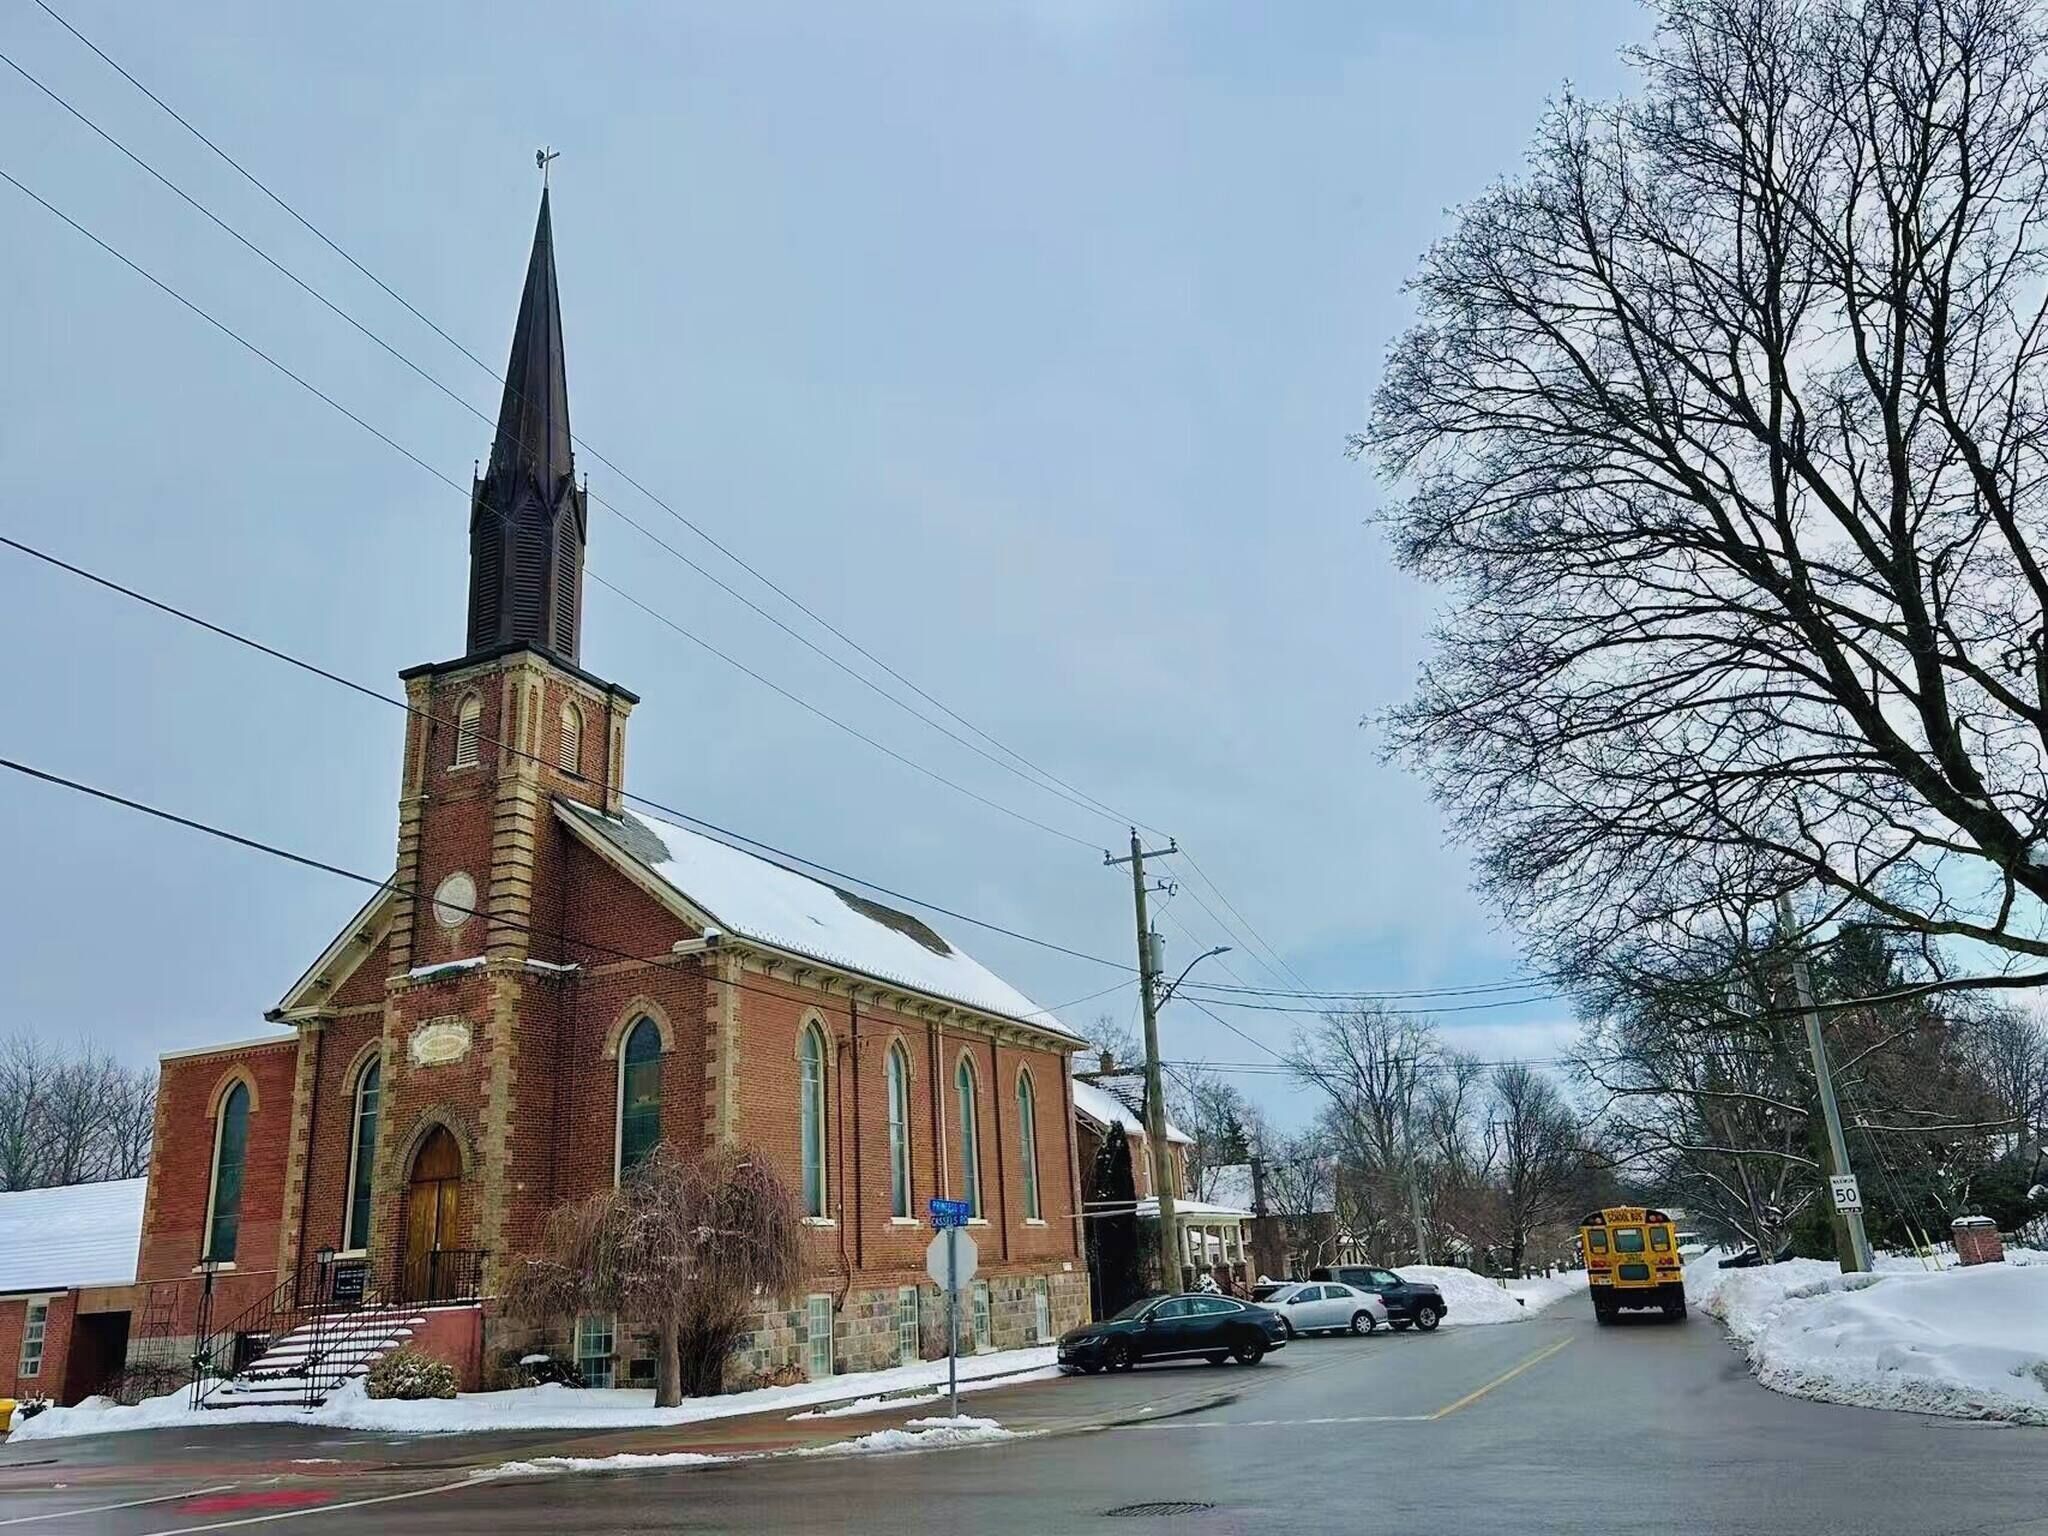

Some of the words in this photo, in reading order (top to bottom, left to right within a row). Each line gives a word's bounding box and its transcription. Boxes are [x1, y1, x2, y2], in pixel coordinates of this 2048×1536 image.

[1836, 1188, 1857, 1203] 50
[931, 1216, 958, 1226] CASSELS
[1607, 1211, 1630, 1223] SCHOOL
[1631, 1211, 1643, 1222] BUS
